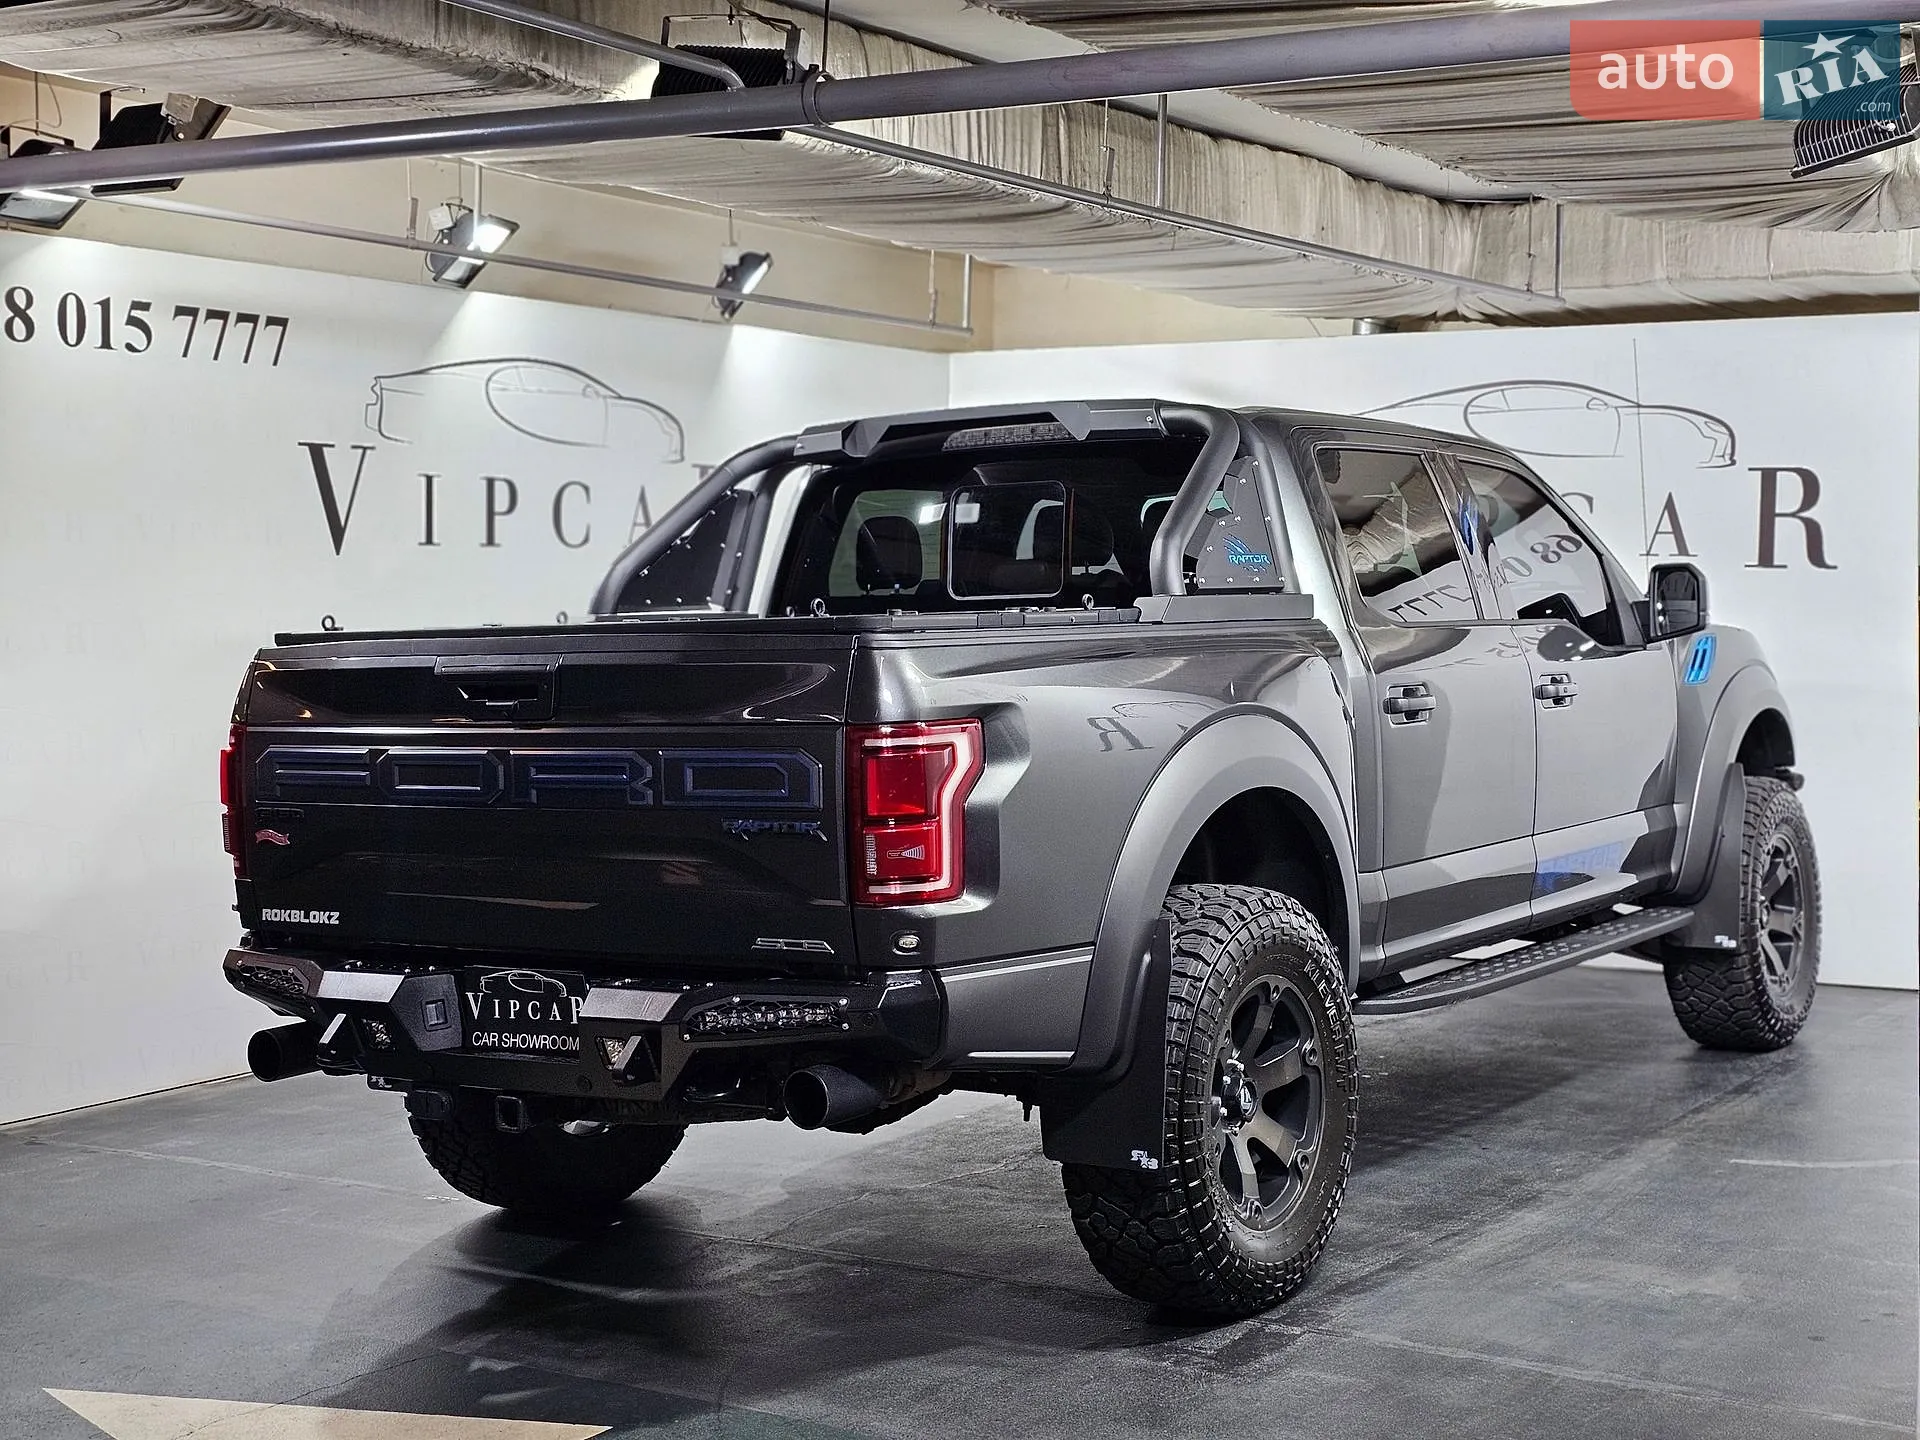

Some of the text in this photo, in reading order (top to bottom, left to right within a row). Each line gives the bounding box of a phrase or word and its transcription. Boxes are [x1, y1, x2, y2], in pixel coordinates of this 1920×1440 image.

[4, 286, 289, 366] 8 015 7777
[298, 441, 716, 556] VIPCA
[1228, 554, 1272, 565] RAPTOR
[256, 745, 824, 809] FORD
[262, 908, 340, 925] ROKBLOKZ
[472, 1031, 580, 1051] CAR SHOWROOM
